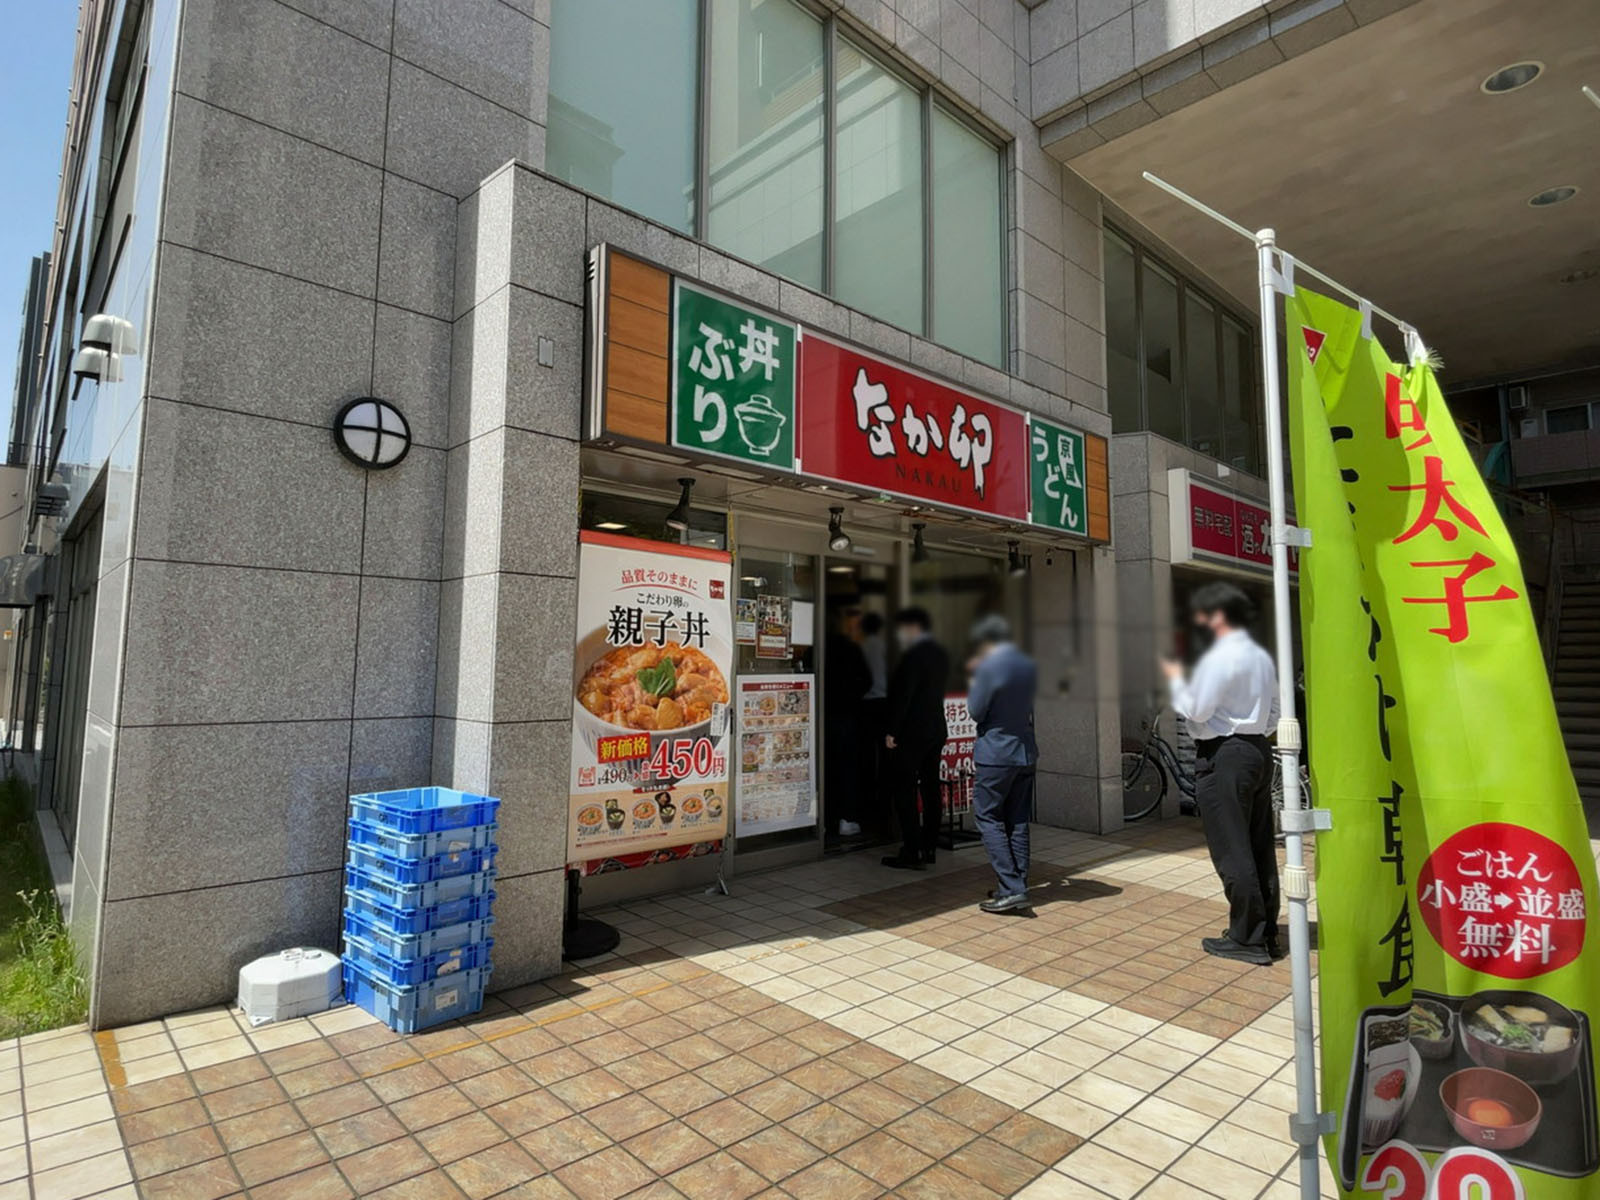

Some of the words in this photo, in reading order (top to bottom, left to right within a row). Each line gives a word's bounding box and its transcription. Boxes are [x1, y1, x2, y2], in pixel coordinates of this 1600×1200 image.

[852, 366, 994, 499] なか卯
[895, 462, 963, 494] NAKAU
[1032, 426, 1079, 528] うどん
[620, 567, 699, 591] 品質そのままに
[606, 604, 712, 649] 親子丼
[600, 737, 649, 760] 新価格
[1455, 847, 1554, 883] ごはん
[1456, 915, 1557, 965] 無料
